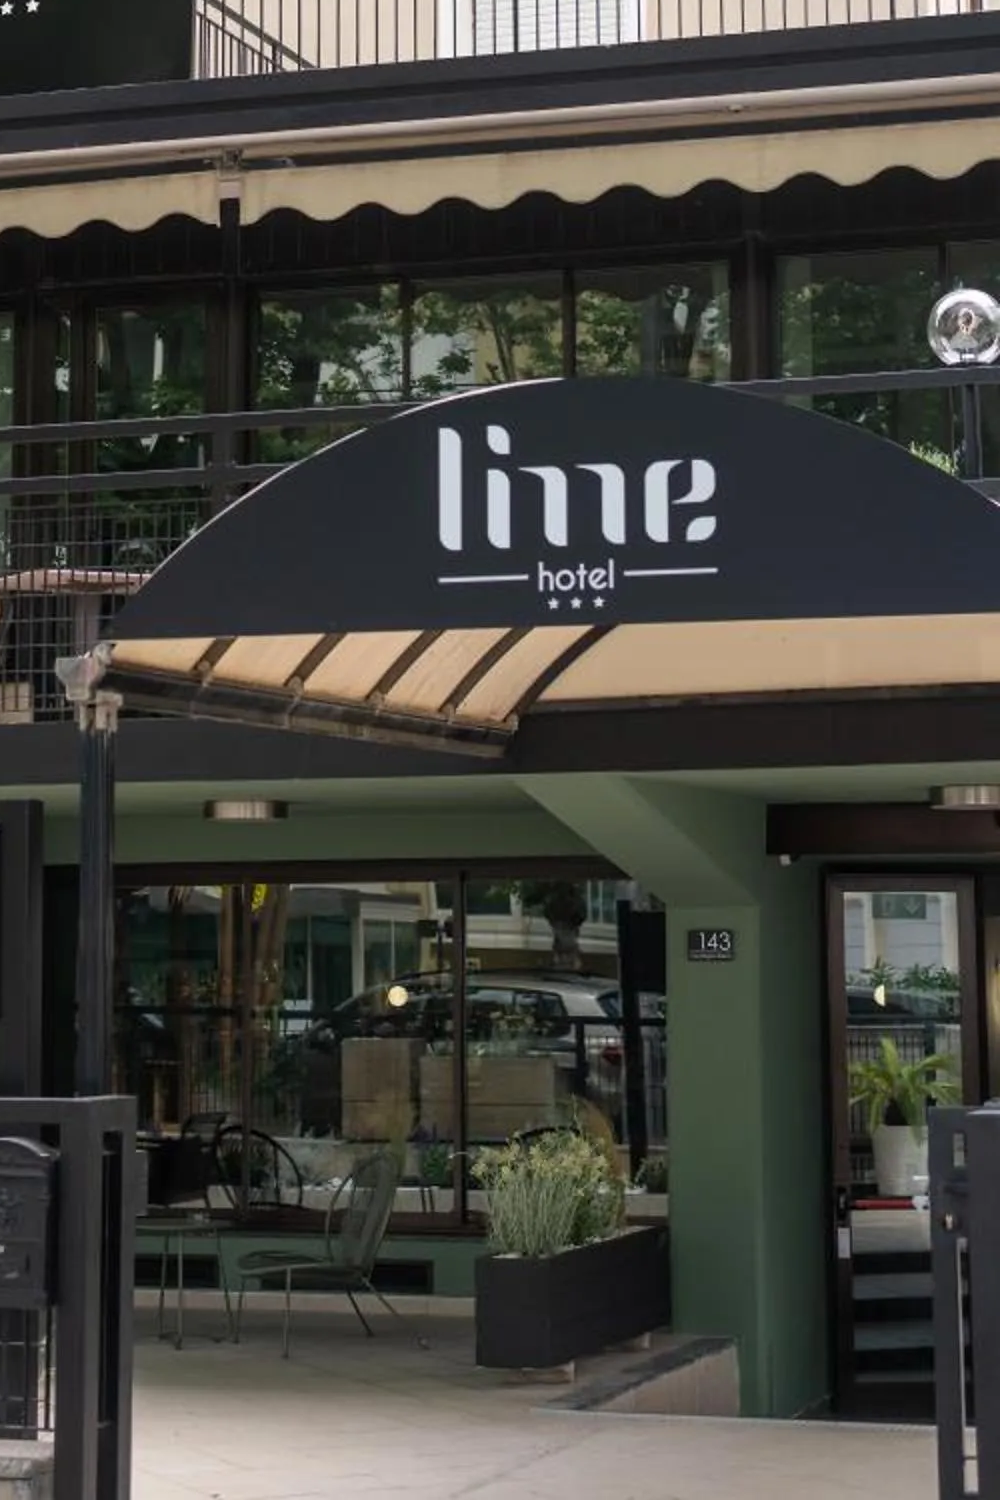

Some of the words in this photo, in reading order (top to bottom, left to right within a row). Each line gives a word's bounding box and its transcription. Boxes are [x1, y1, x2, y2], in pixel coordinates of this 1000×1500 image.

[438, 425, 717, 551] lime
[538, 558, 615, 592] hotel
[699, 931, 731, 951] 143
